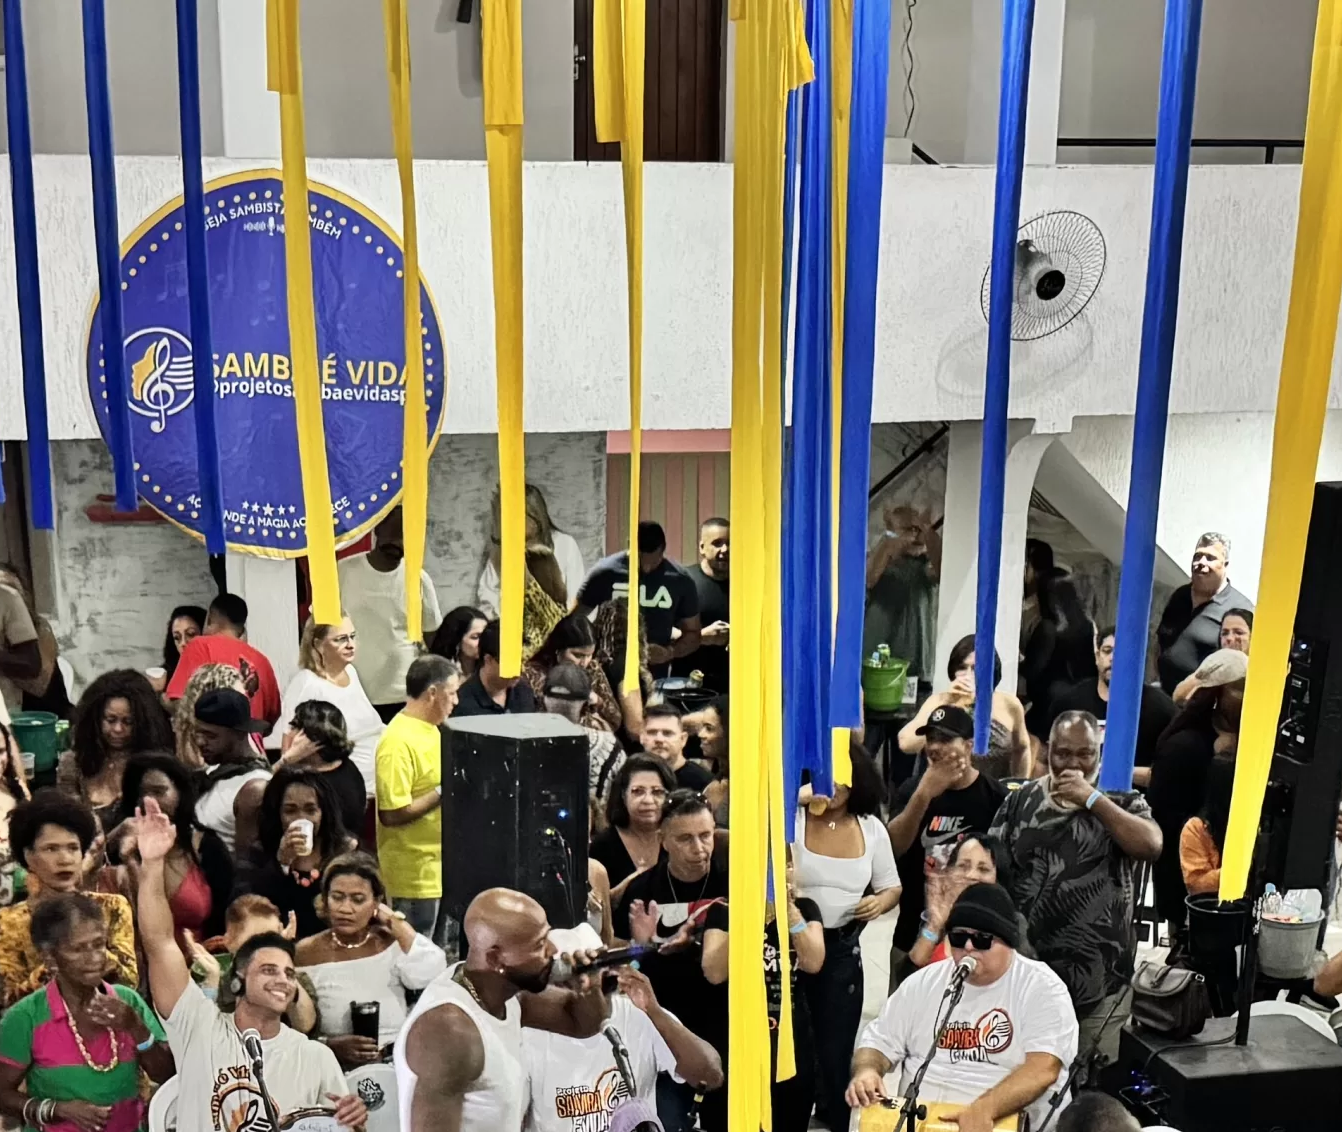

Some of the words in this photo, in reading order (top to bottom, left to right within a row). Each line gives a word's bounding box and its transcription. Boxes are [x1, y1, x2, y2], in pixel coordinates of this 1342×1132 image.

[322, 353, 337, 385] É
[257, 517, 291, 529] MAGIA
[611, 582, 673, 609] FLA
[929, 815, 965, 832] NIKE
